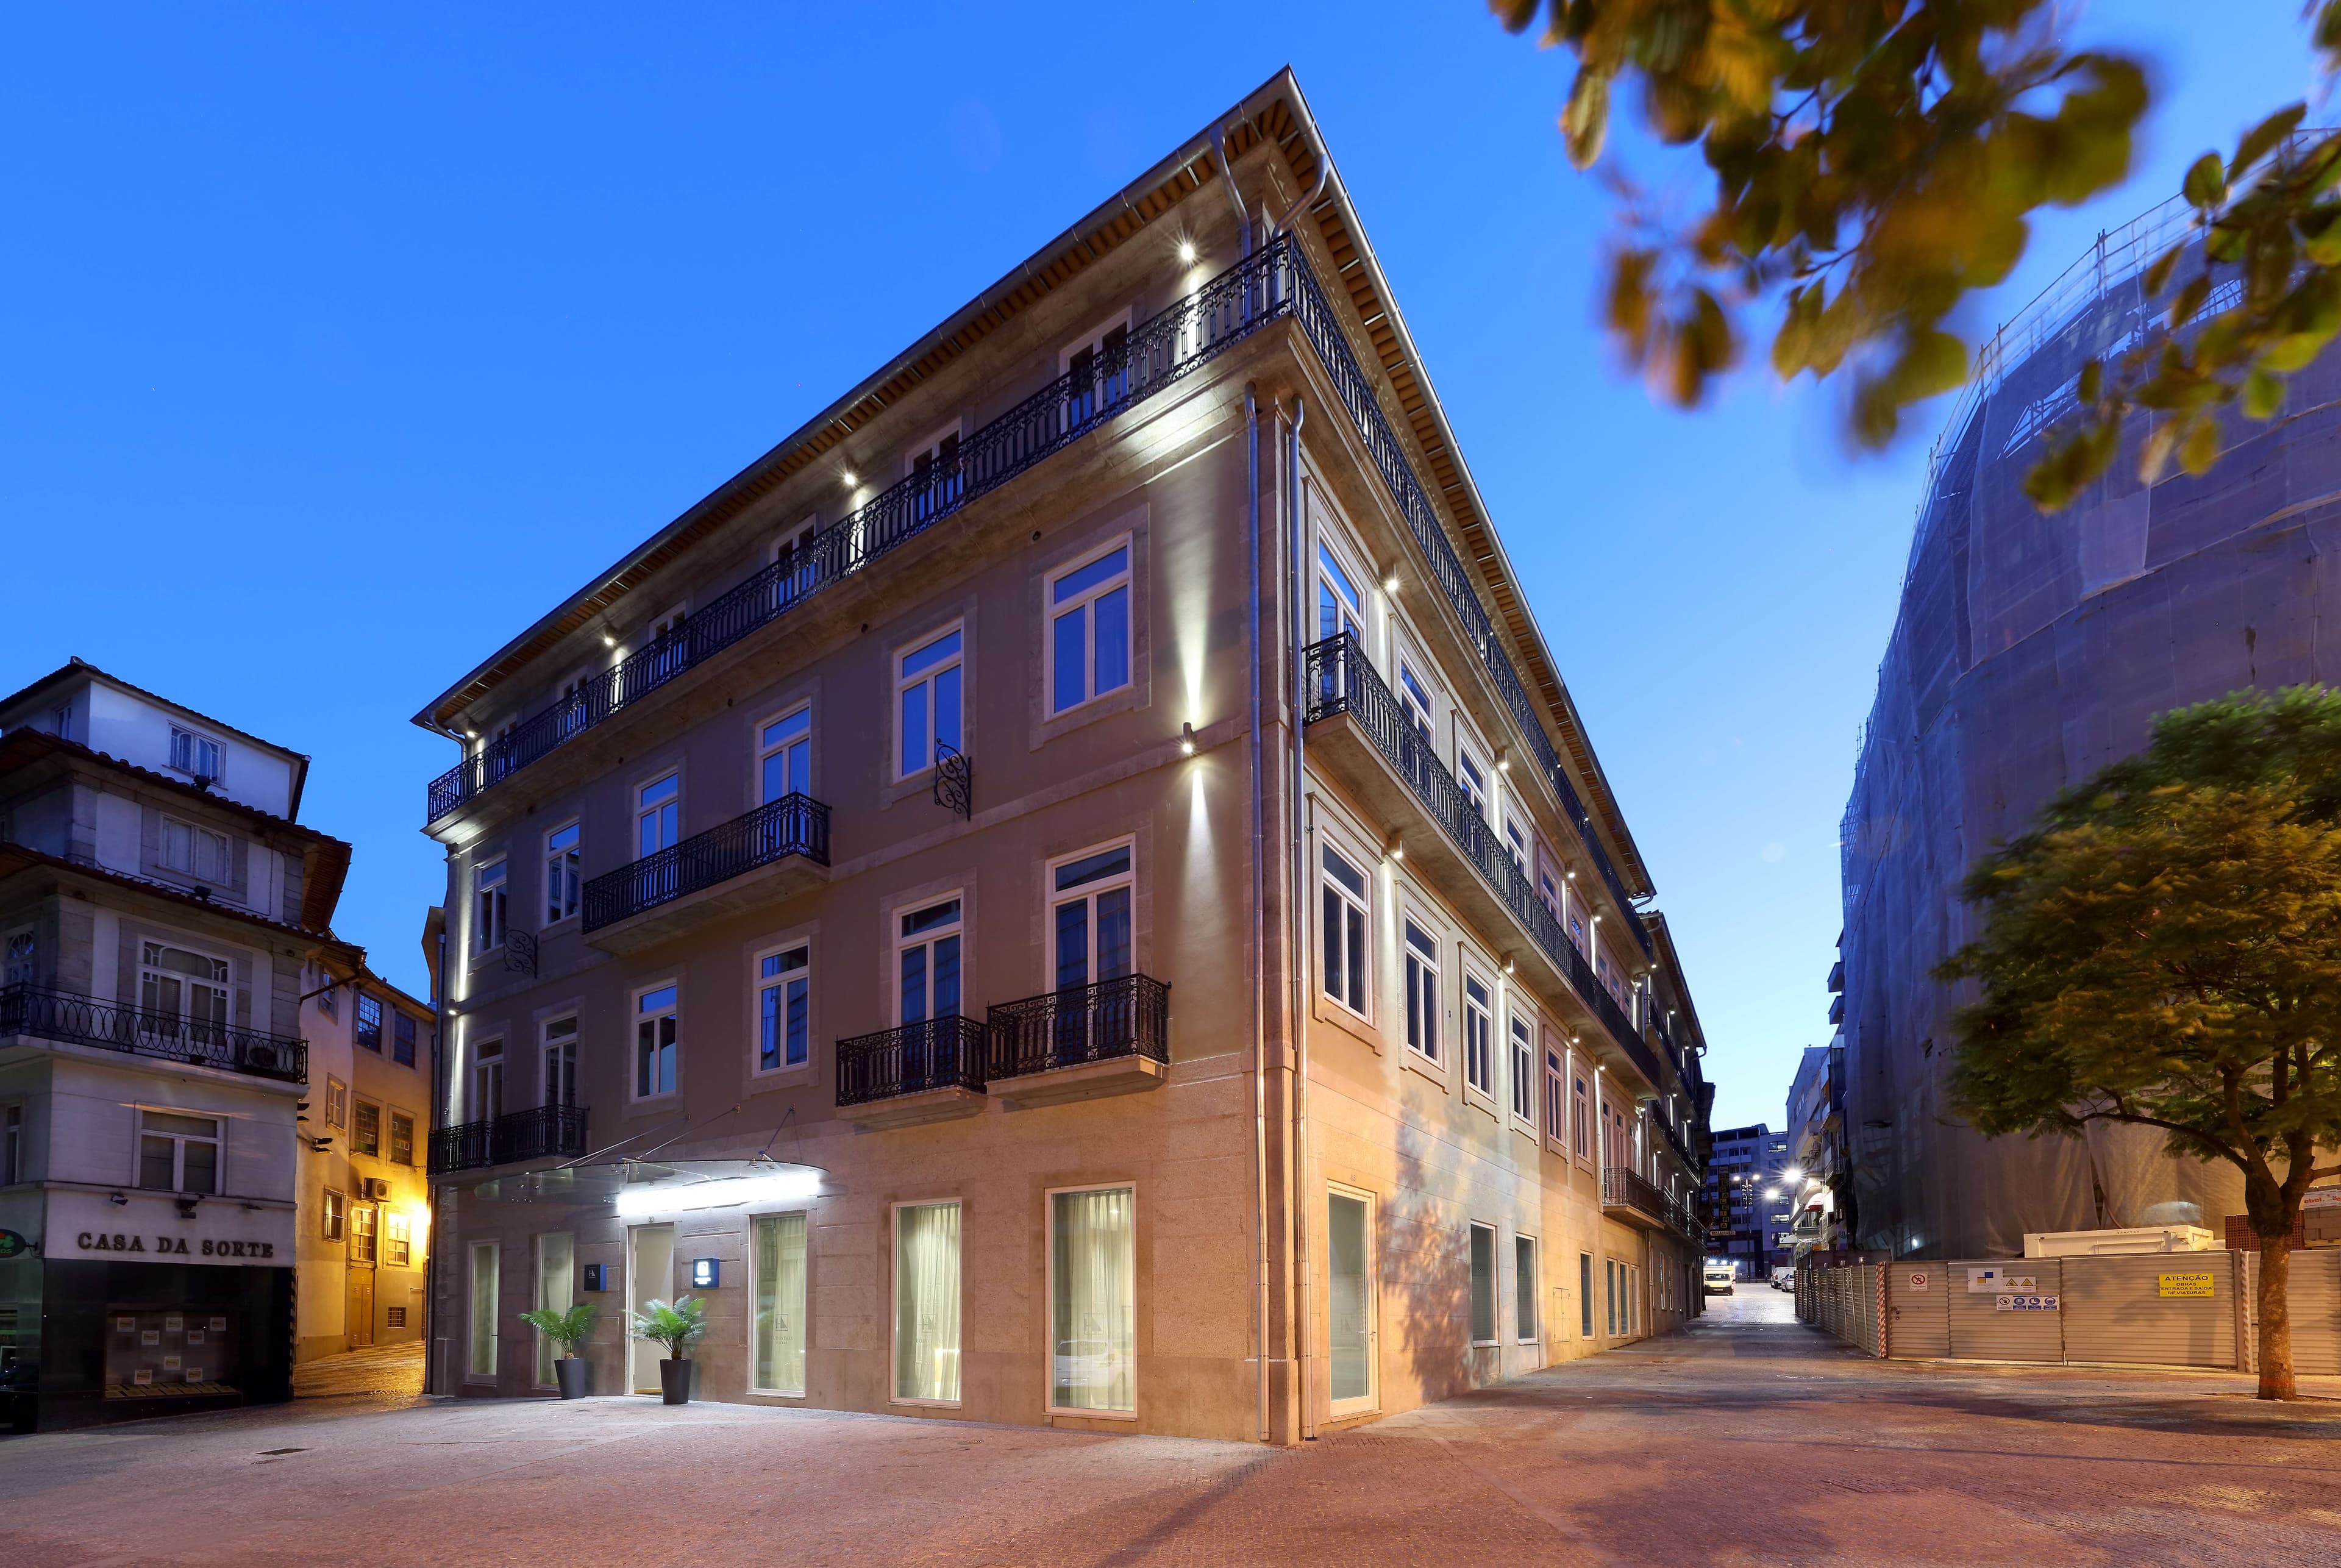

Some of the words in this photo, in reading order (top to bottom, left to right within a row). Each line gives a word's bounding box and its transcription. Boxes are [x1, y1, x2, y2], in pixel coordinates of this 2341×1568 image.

[77, 1232, 146, 1252] CASA
[156, 1236, 191, 1255] DA
[201, 1239, 274, 1258] SORTE
